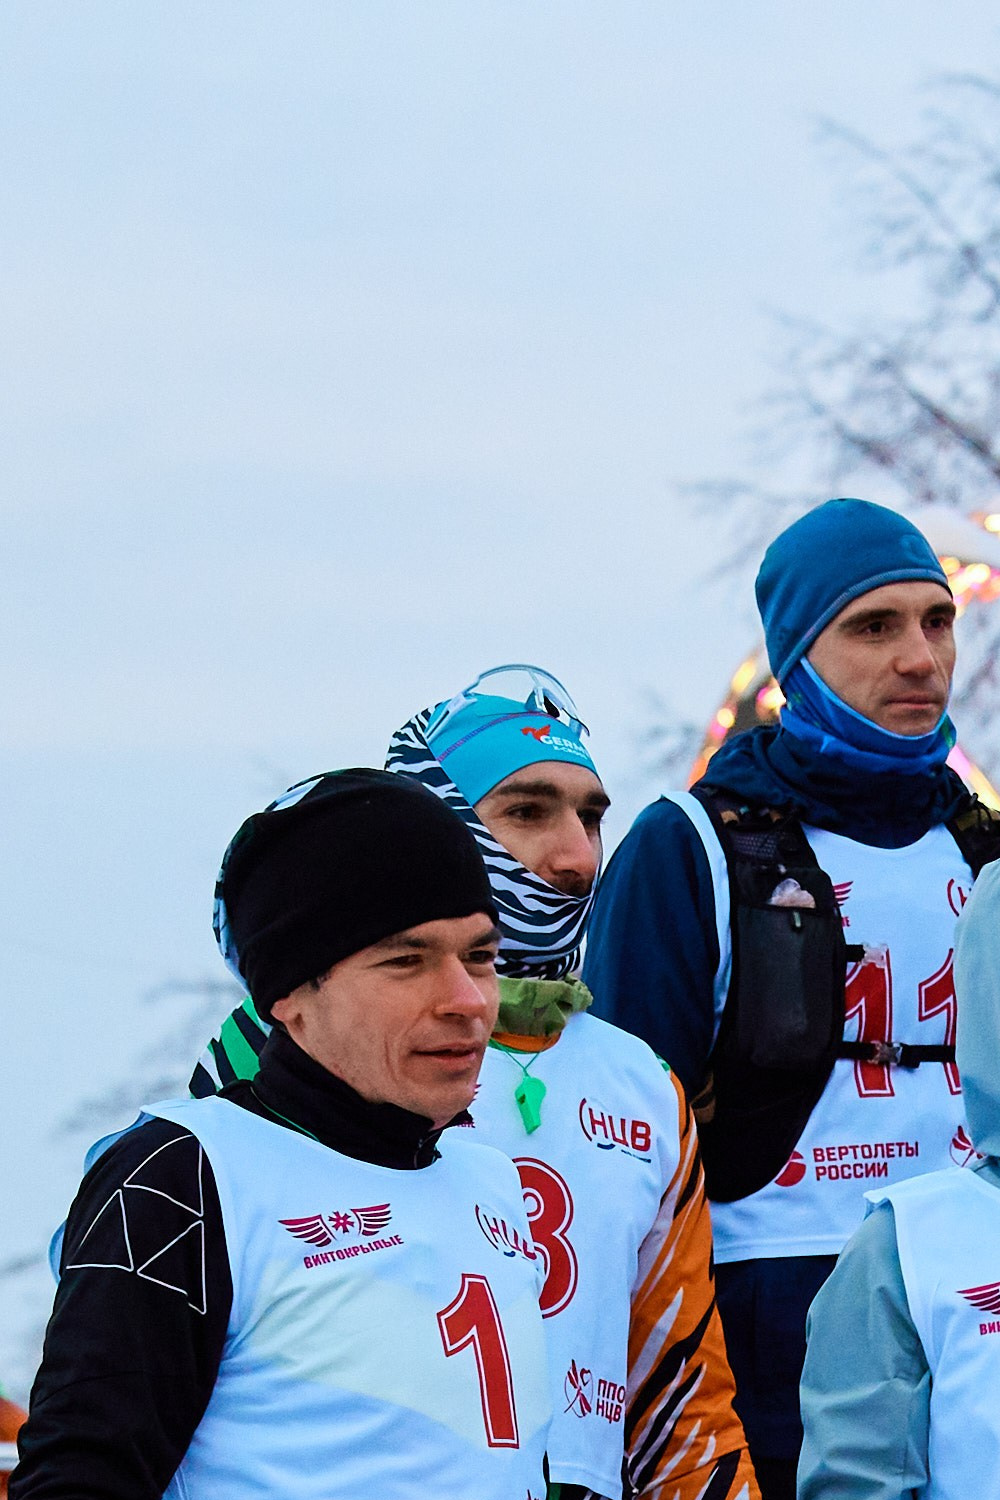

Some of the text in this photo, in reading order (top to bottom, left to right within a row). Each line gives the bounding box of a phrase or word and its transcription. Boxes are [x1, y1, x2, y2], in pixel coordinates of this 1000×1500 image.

[588, 1107, 652, 1153] НЦВ
[812, 1141, 919, 1163] ВЕРТОЛЕТЫ
[815, 1160, 889, 1182] РОССИИ
[303, 1235, 404, 1270] ВИНТОКРЫЛЫЕ
[436, 1273, 519, 1449] 1
[597, 1379, 626, 1404] ППО
[596, 1398, 623, 1424] НЦВ
